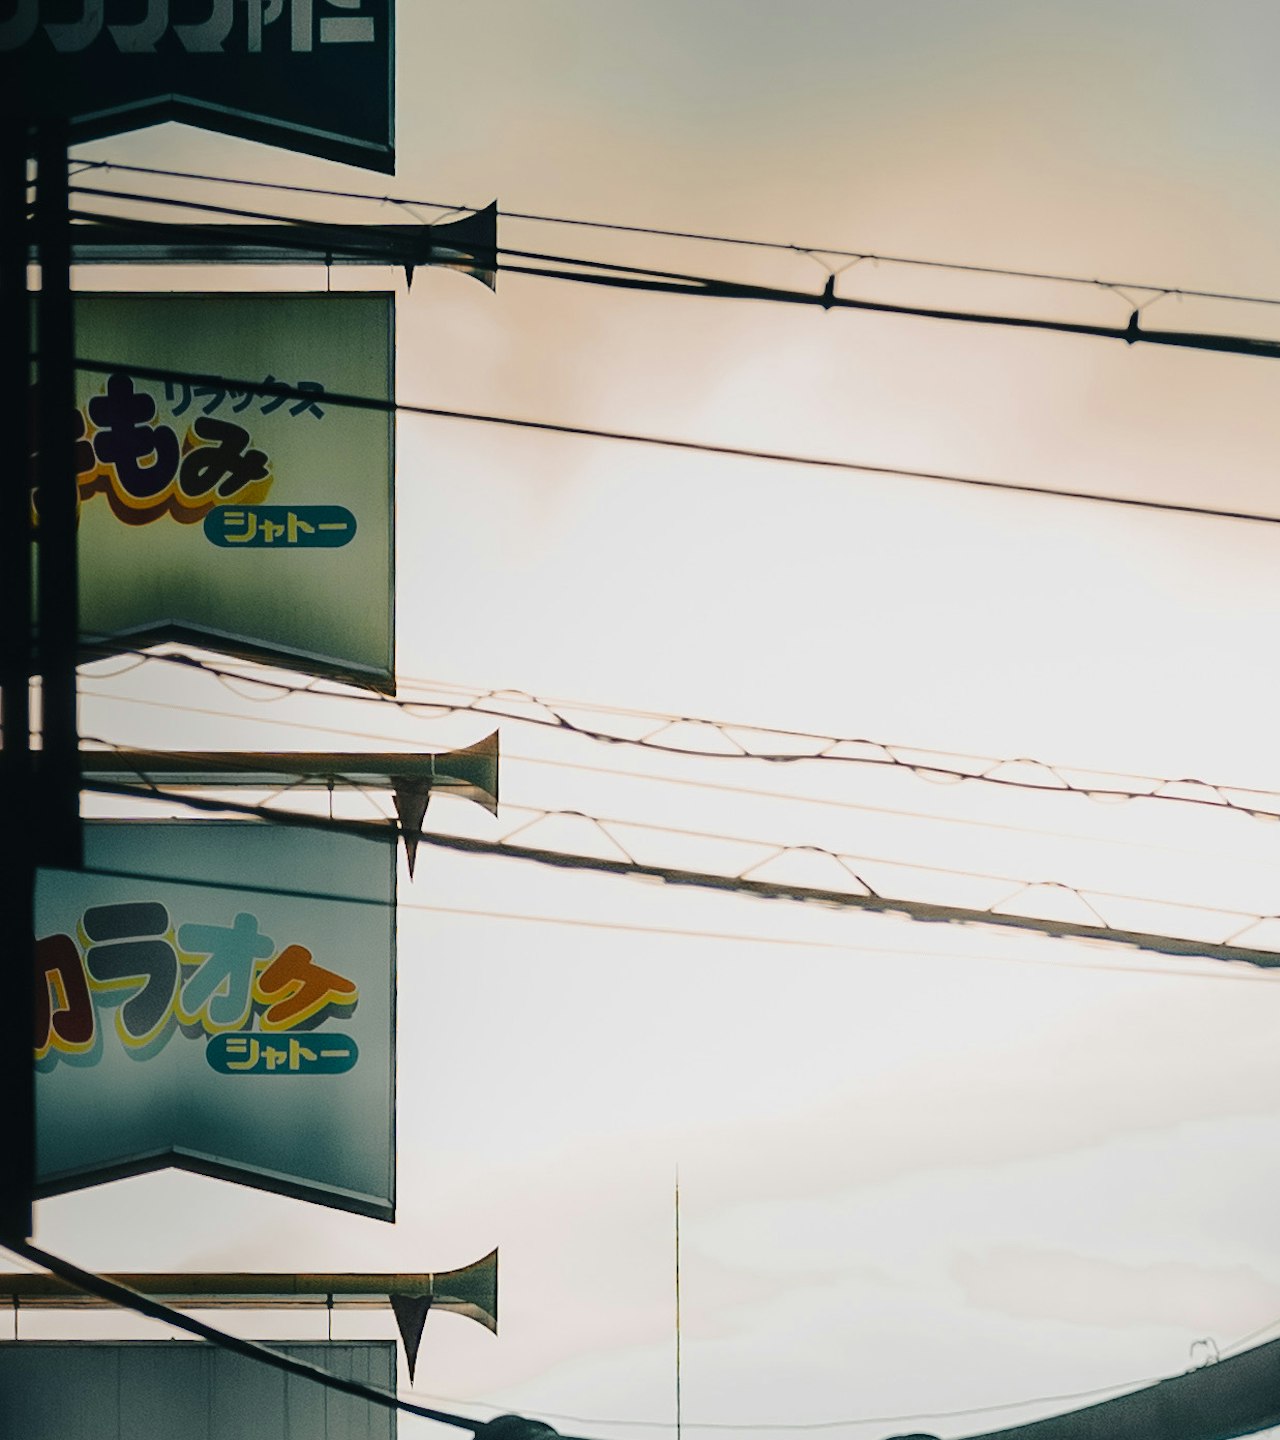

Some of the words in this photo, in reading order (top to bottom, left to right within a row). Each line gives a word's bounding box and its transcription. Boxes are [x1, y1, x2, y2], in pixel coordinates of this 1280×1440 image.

[165, 374, 328, 420] リラックス
[75, 373, 270, 498] もみ
[223, 511, 348, 544] シャトー
[225, 1037, 351, 1071] シャトー
